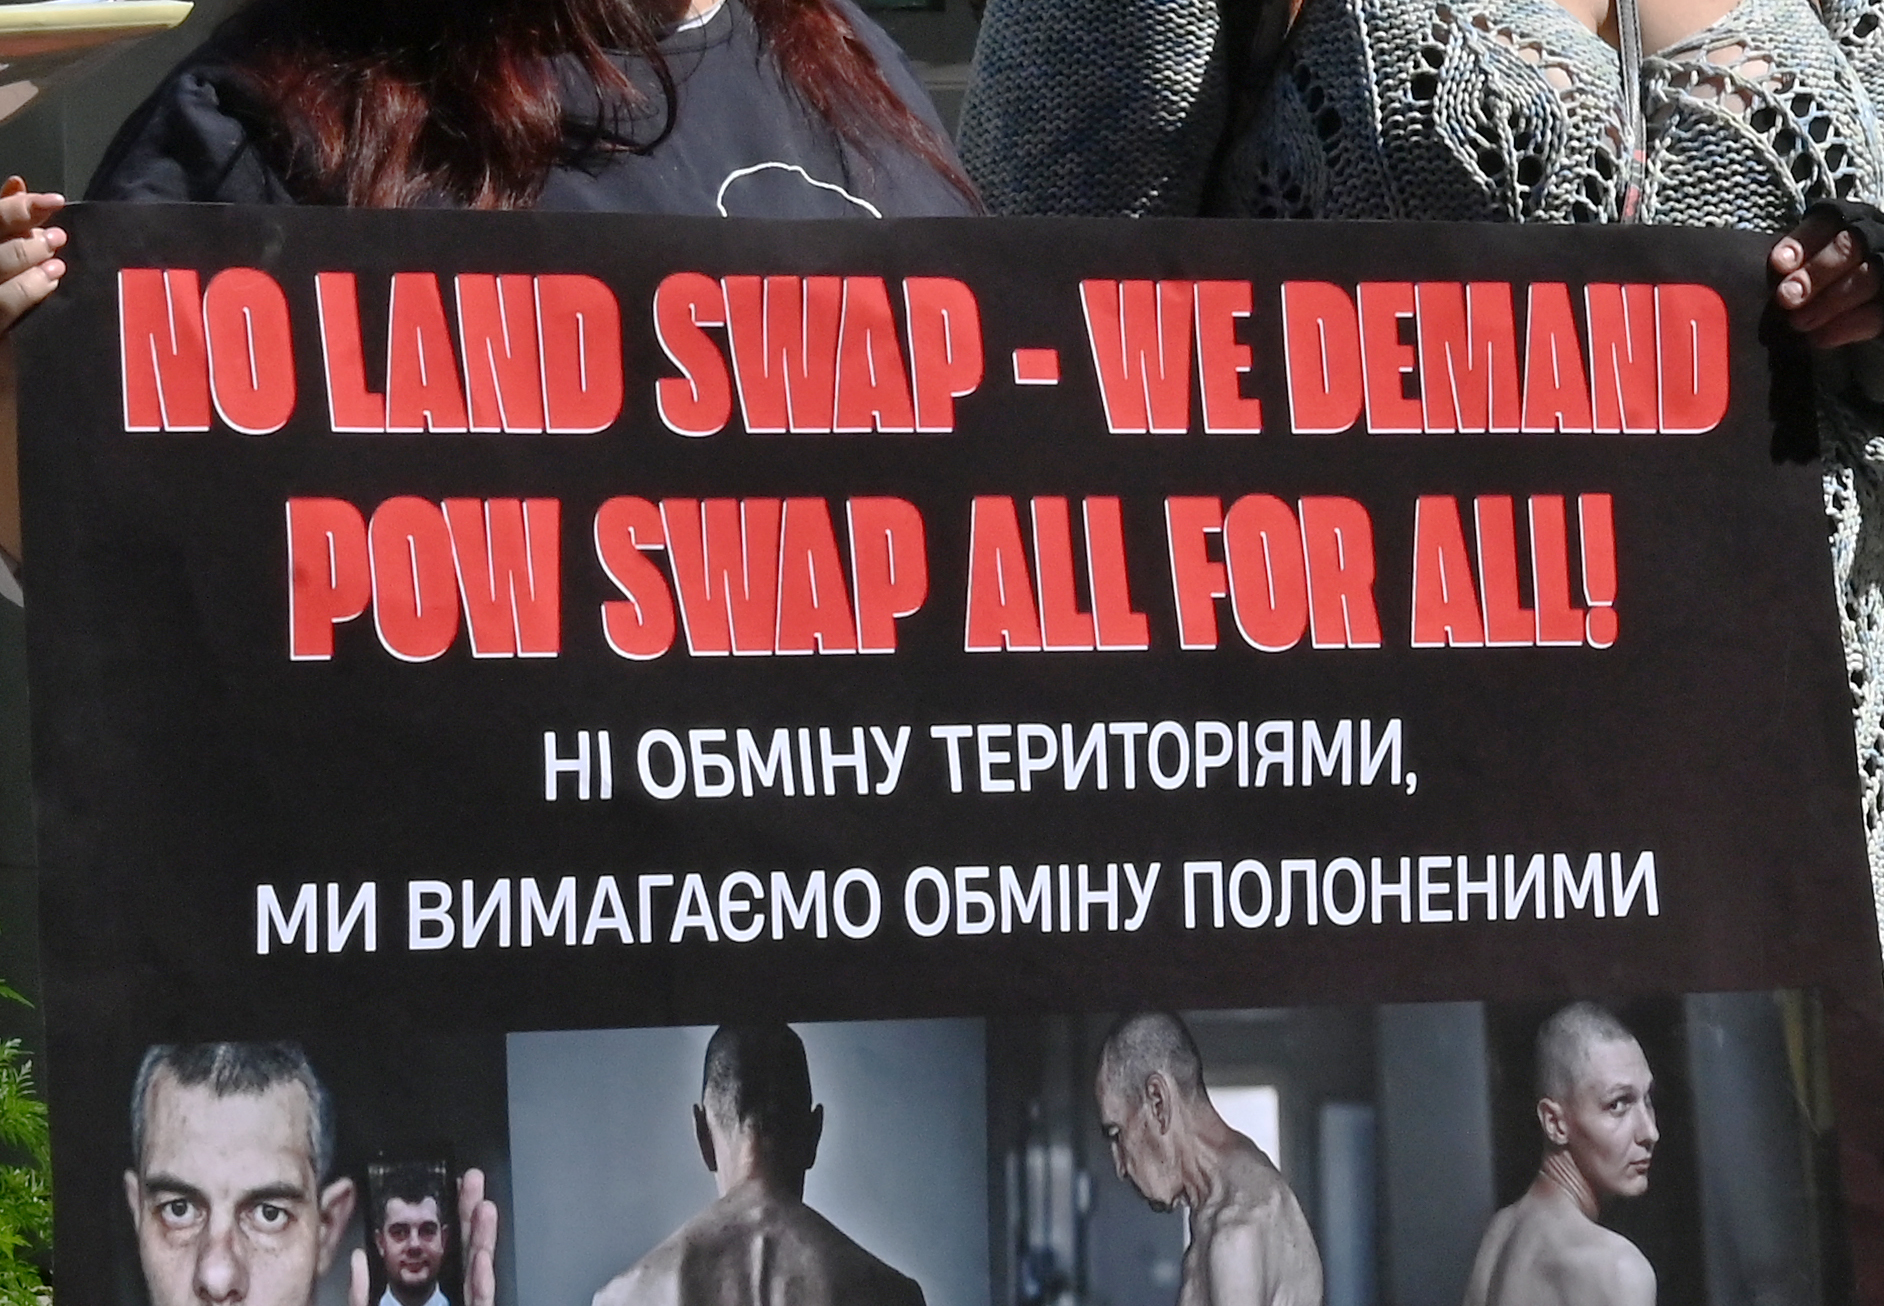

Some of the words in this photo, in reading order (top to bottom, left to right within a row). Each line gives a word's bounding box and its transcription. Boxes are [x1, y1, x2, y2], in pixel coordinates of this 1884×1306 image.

[117, 266, 297, 436] NO
[314, 271, 625, 435] LAND
[653, 271, 985, 438] SWAP
[1012, 348, 1061, 385] -
[1078, 278, 1263, 436] WE
[1280, 280, 1730, 436] DEMAND
[285, 495, 561, 664] POW
[593, 495, 929, 662] SWAP
[964, 495, 1151, 654] ALL
[1164, 493, 1383, 654] FOR
[1410, 492, 1620, 650] ALL!
[542, 729, 613, 802] НІ
[635, 725, 913, 801] ОБМІНУ
[929, 717, 1418, 797] ТЕРИТОРІЯМИ,
[255, 881, 378, 956] МИ
[407, 866, 882, 953] ВИМАГАЄМО
[903, 862, 1162, 938] ОБМІНУ
[1182, 849, 1661, 930] ПОЛОНЕНИМИ
